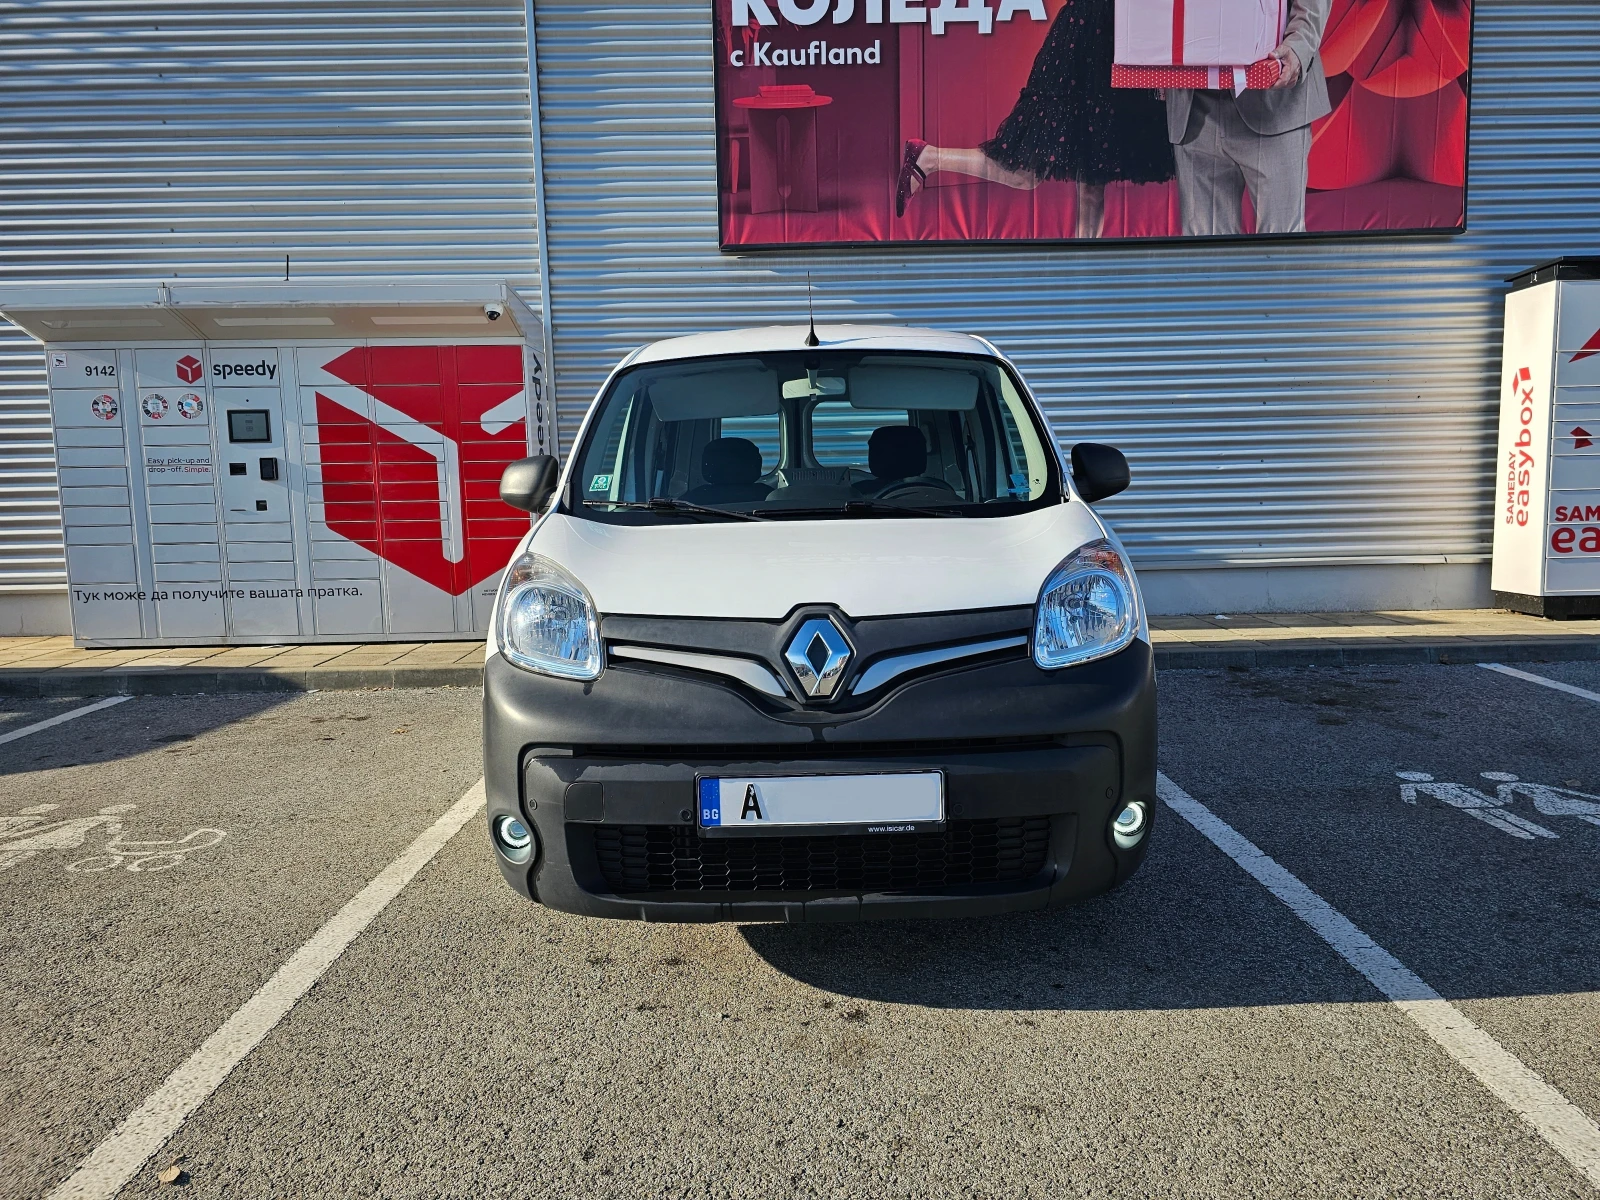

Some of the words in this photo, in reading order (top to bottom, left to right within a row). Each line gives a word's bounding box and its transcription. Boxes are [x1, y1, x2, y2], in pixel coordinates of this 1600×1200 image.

[753, 39, 881, 66] Kaufland
[85, 365, 115, 376] 9142
[212, 360, 277, 379] speedy
[147, 457, 165, 466] Easy
[167, 457, 195, 466] pick-up
[1514, 386, 1534, 527] easybox
[1505, 451, 1517, 525] SAMEDAY
[73, 590, 101, 603] Тук
[103, 590, 146, 601] може
[151, 590, 169, 601] да
[172, 588, 245, 601] получите
[249, 588, 303, 599] вашата
[307, 587, 363, 599] пратка.
[703, 809, 719, 820] BG
[867, 824, 916, 833] www.isicar.de
